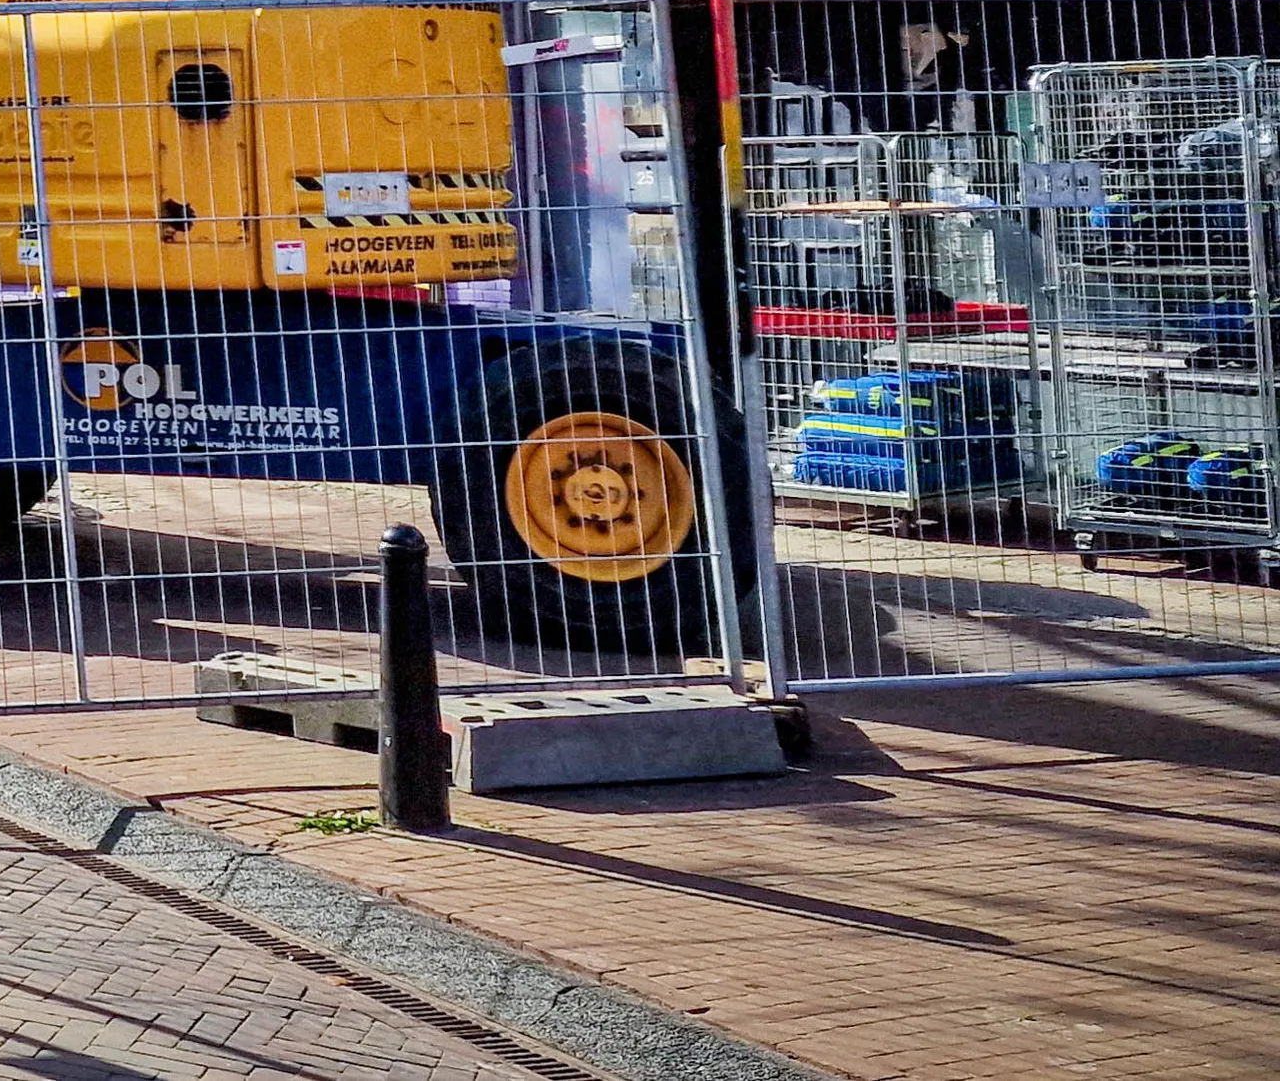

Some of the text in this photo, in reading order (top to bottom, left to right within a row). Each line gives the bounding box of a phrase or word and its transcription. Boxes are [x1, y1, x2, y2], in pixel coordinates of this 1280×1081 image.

[325, 235, 435, 253] HOOGEVEEN
[326, 258, 416, 276] ALKMAAR
[85, 363, 196, 399] POL
[135, 403, 339, 424] HOOGWERKERS
[64, 418, 198, 434] HOOGEVEEN
[229, 423, 340, 439] ALKMAAR
[124, 437, 139, 446] 27
